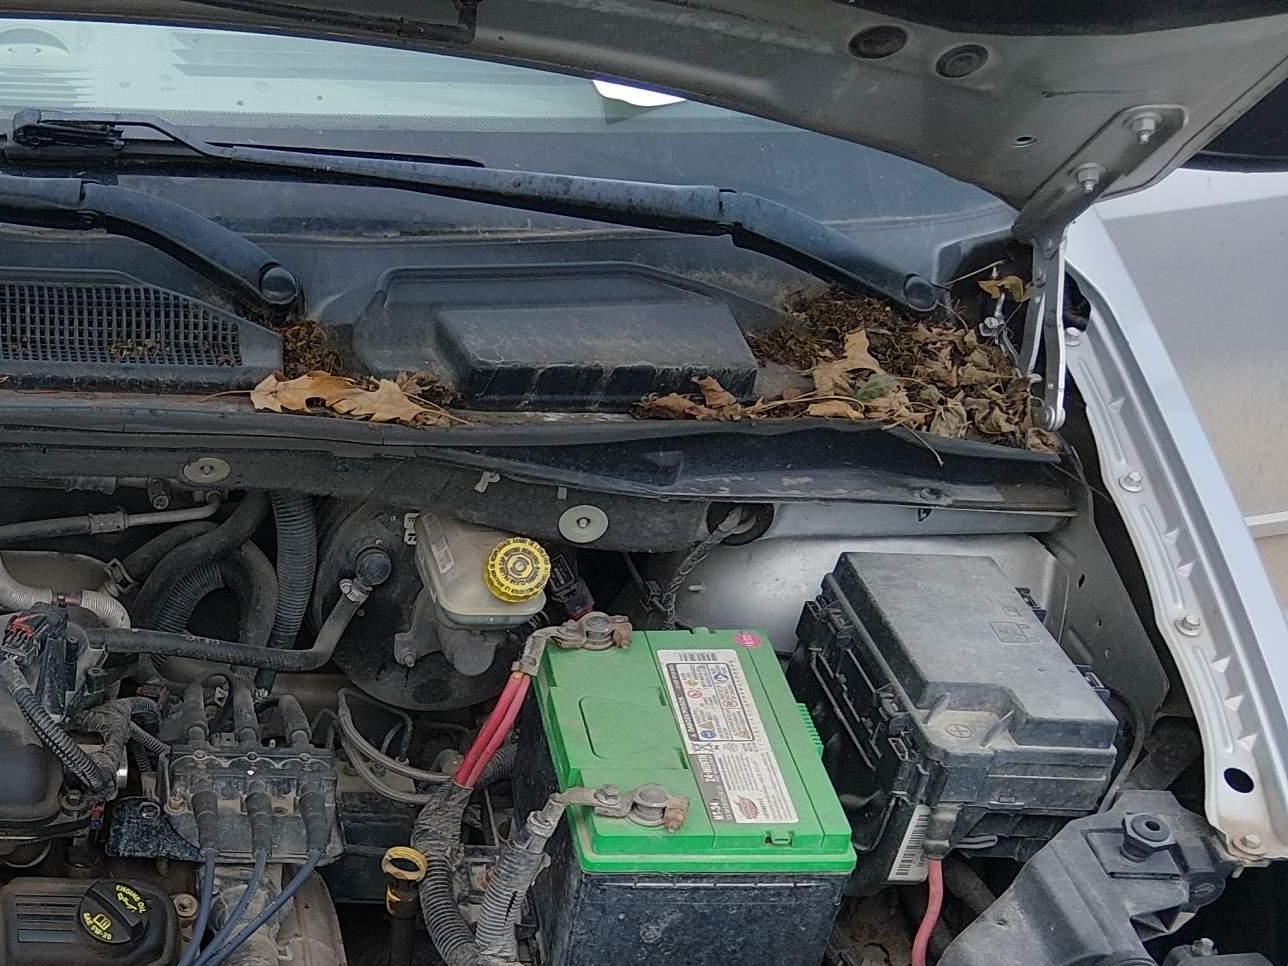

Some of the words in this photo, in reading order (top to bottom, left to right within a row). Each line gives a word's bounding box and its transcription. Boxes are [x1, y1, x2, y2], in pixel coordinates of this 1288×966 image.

[115, 884, 141, 902] ENGINE
[137, 901, 147, 913] OIL
[83, 912, 94, 926] SAE
[91, 925, 112, 940] 5W-20
